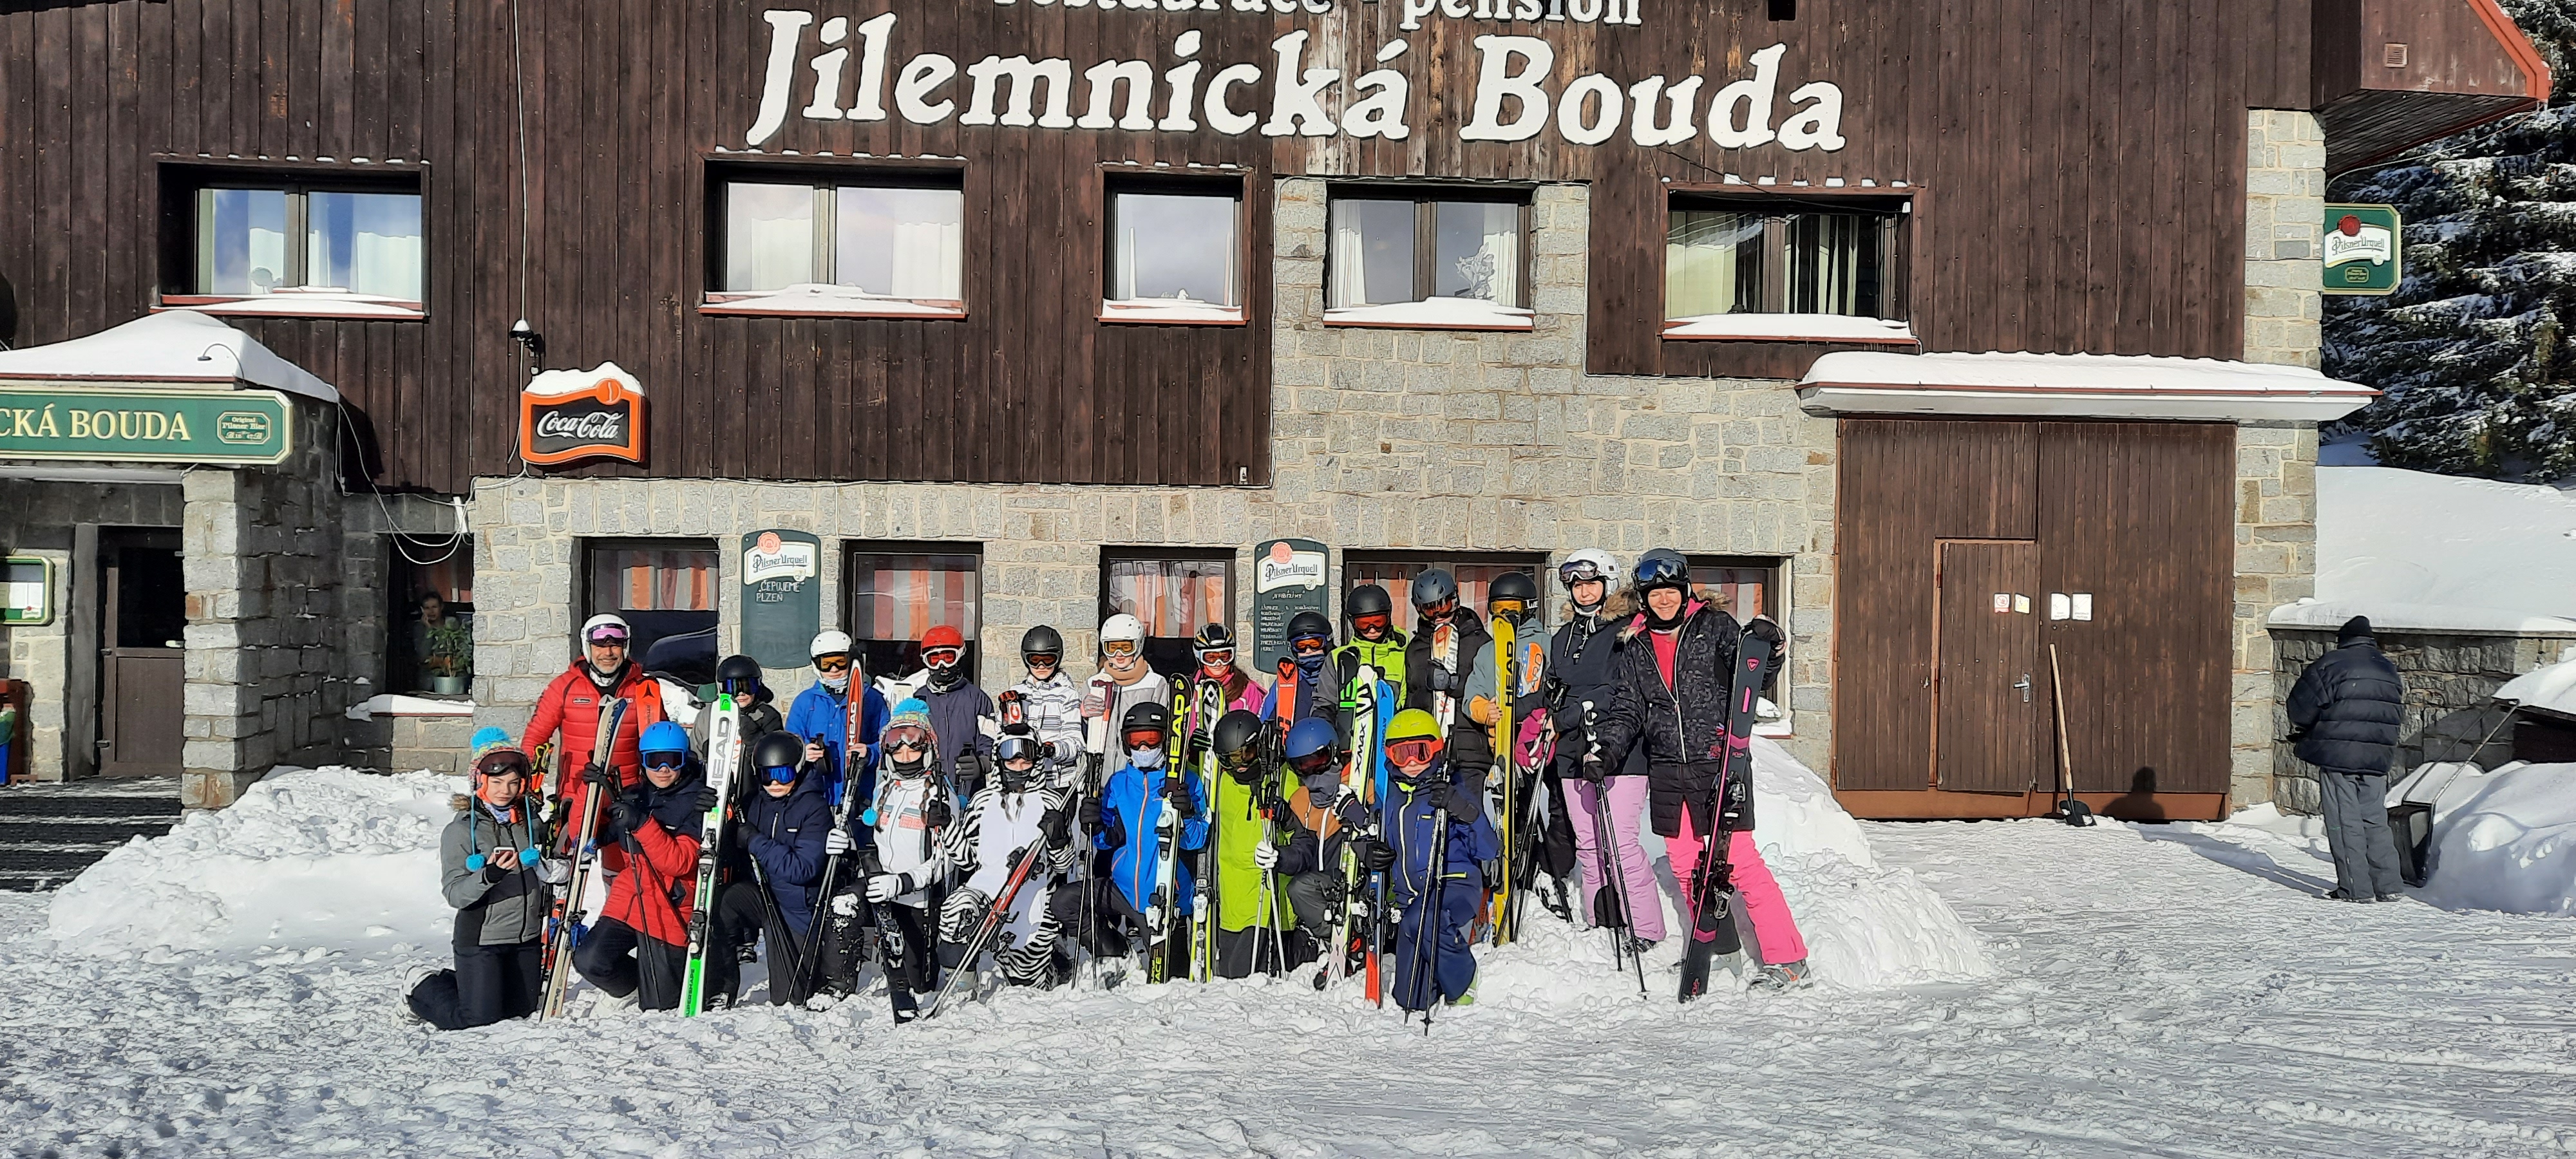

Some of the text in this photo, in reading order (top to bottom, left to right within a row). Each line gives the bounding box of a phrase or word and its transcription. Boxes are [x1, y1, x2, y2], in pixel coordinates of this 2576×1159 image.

[745, 9, 1846, 154] Jilemnická Bouda
[2331, 236, 2362, 256] Pilsner
[68, 410, 191, 442] BOUDA
[536, 411, 625, 439] Coca-Cola
[752, 554, 808, 573] Pilsner Urquell
[1265, 563, 1292, 582] Pilsner
[849, 701, 857, 746] HEAD
[1168, 694, 1185, 778] HEAD
[712, 717, 730, 798] HEAD
